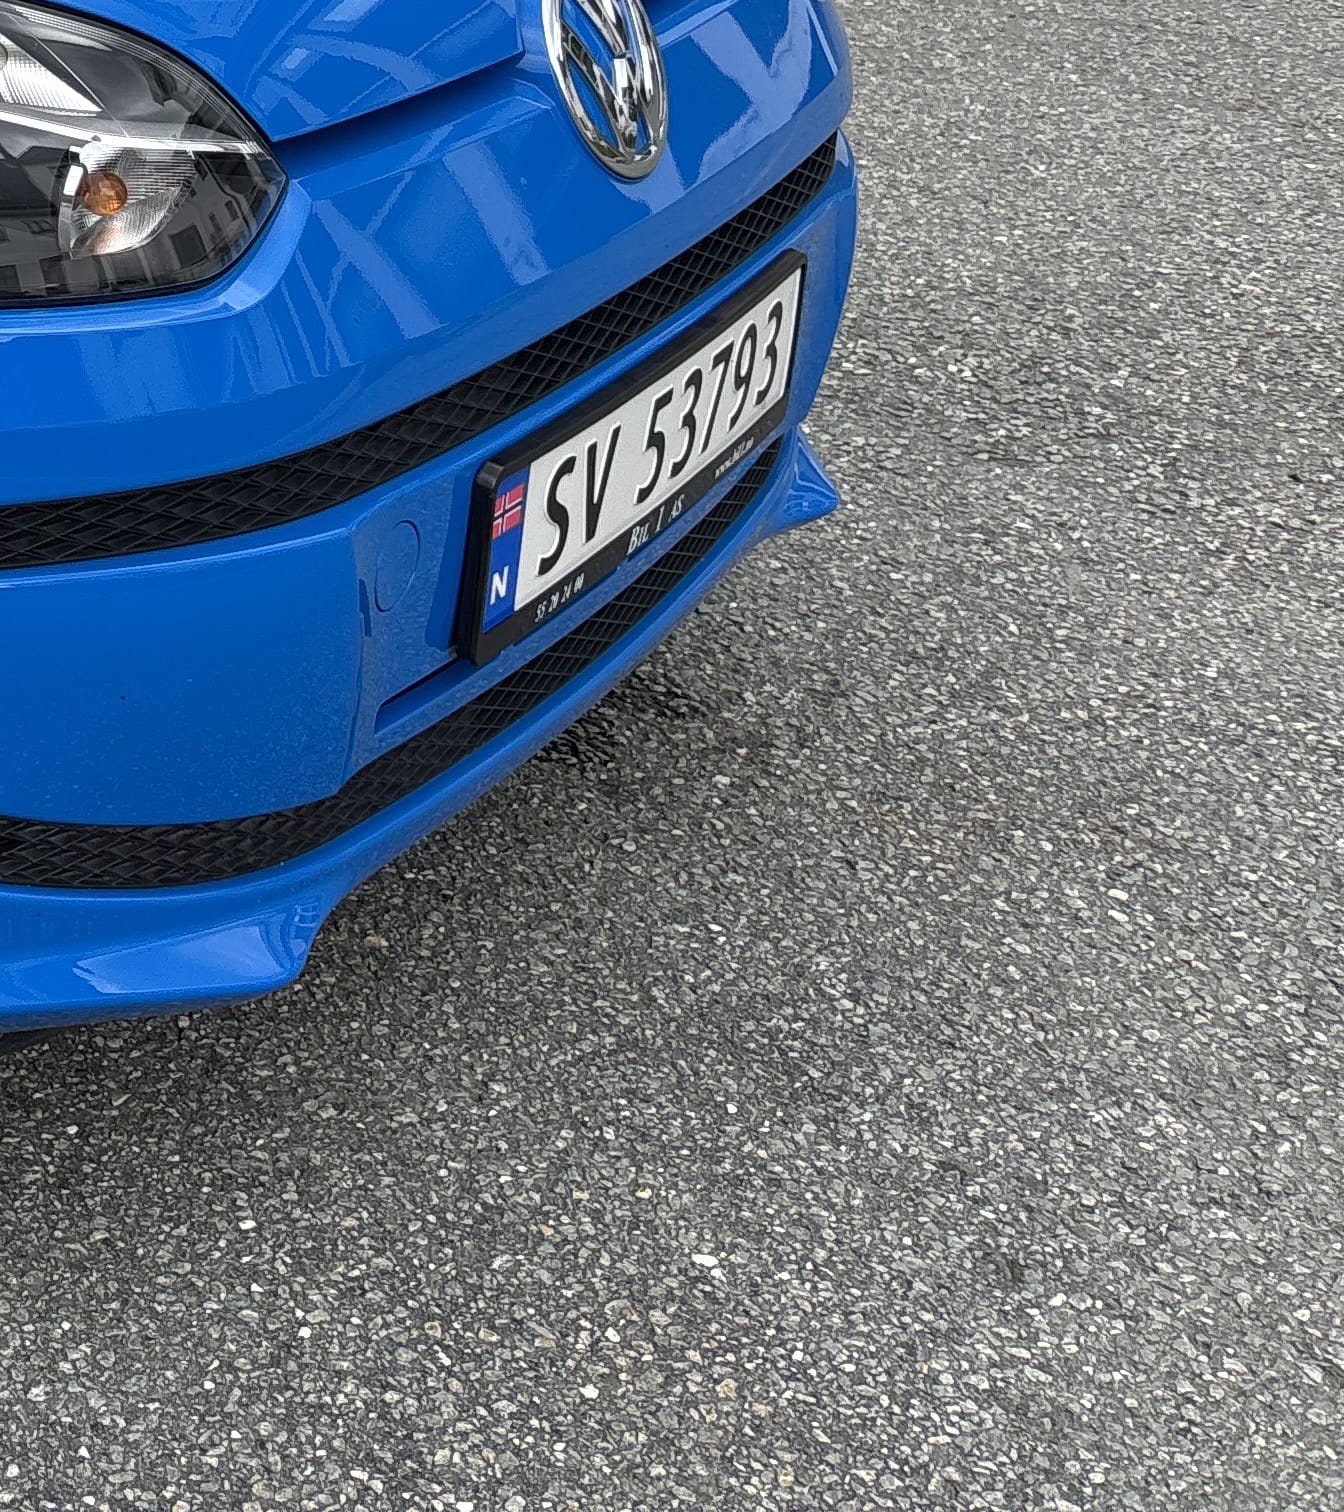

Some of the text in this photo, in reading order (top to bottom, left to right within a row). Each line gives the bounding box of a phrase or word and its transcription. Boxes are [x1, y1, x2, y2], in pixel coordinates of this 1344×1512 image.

[537, 299, 783, 577] SV 53793
[490, 564, 509, 606] N
